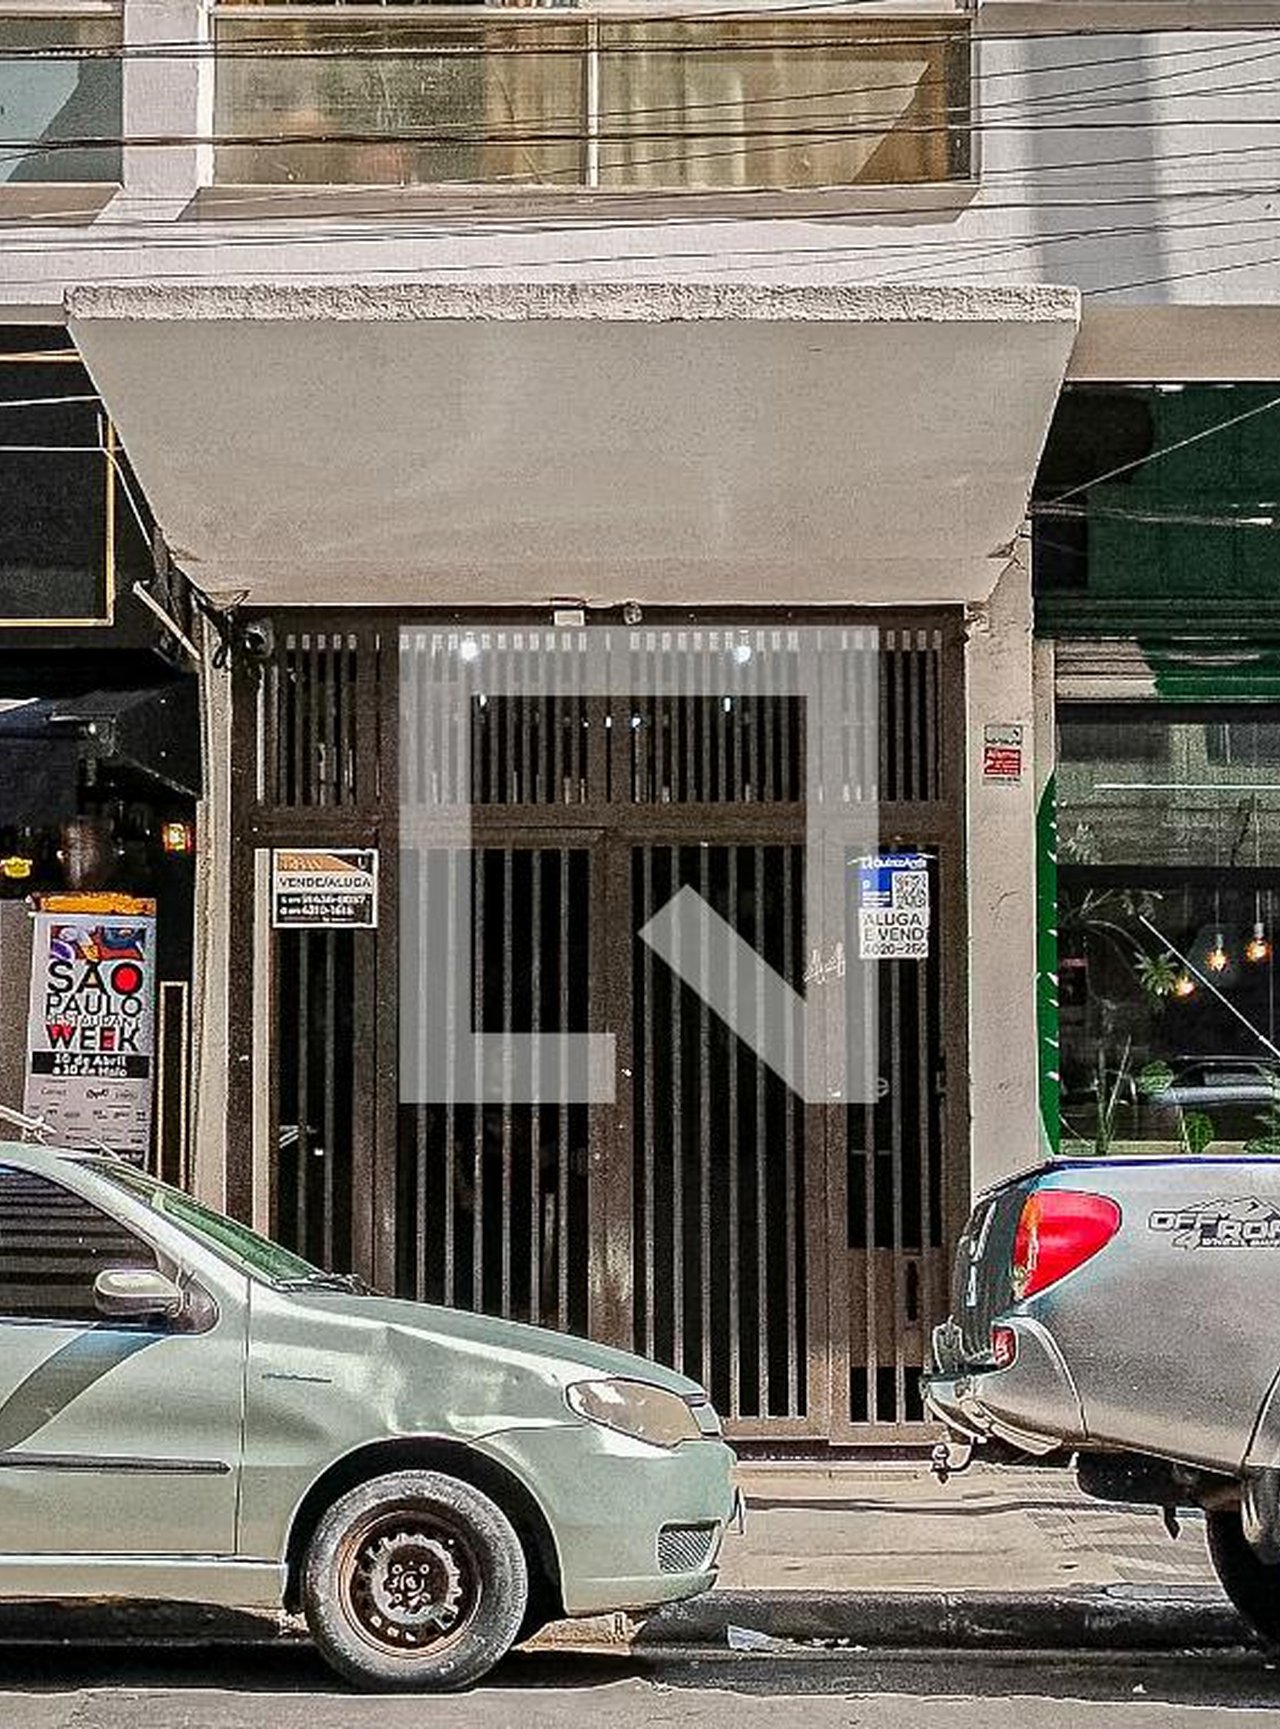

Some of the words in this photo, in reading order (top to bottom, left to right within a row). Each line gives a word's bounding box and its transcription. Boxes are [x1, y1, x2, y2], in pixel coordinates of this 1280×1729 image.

[279, 877, 372, 888] VENDE/ALUGA
[863, 912, 923, 926] ALUGA
[45, 993, 142, 1018] PAULO
[45, 1024, 140, 1052] WEEK
[1149, 1211, 1220, 1231] OFF
